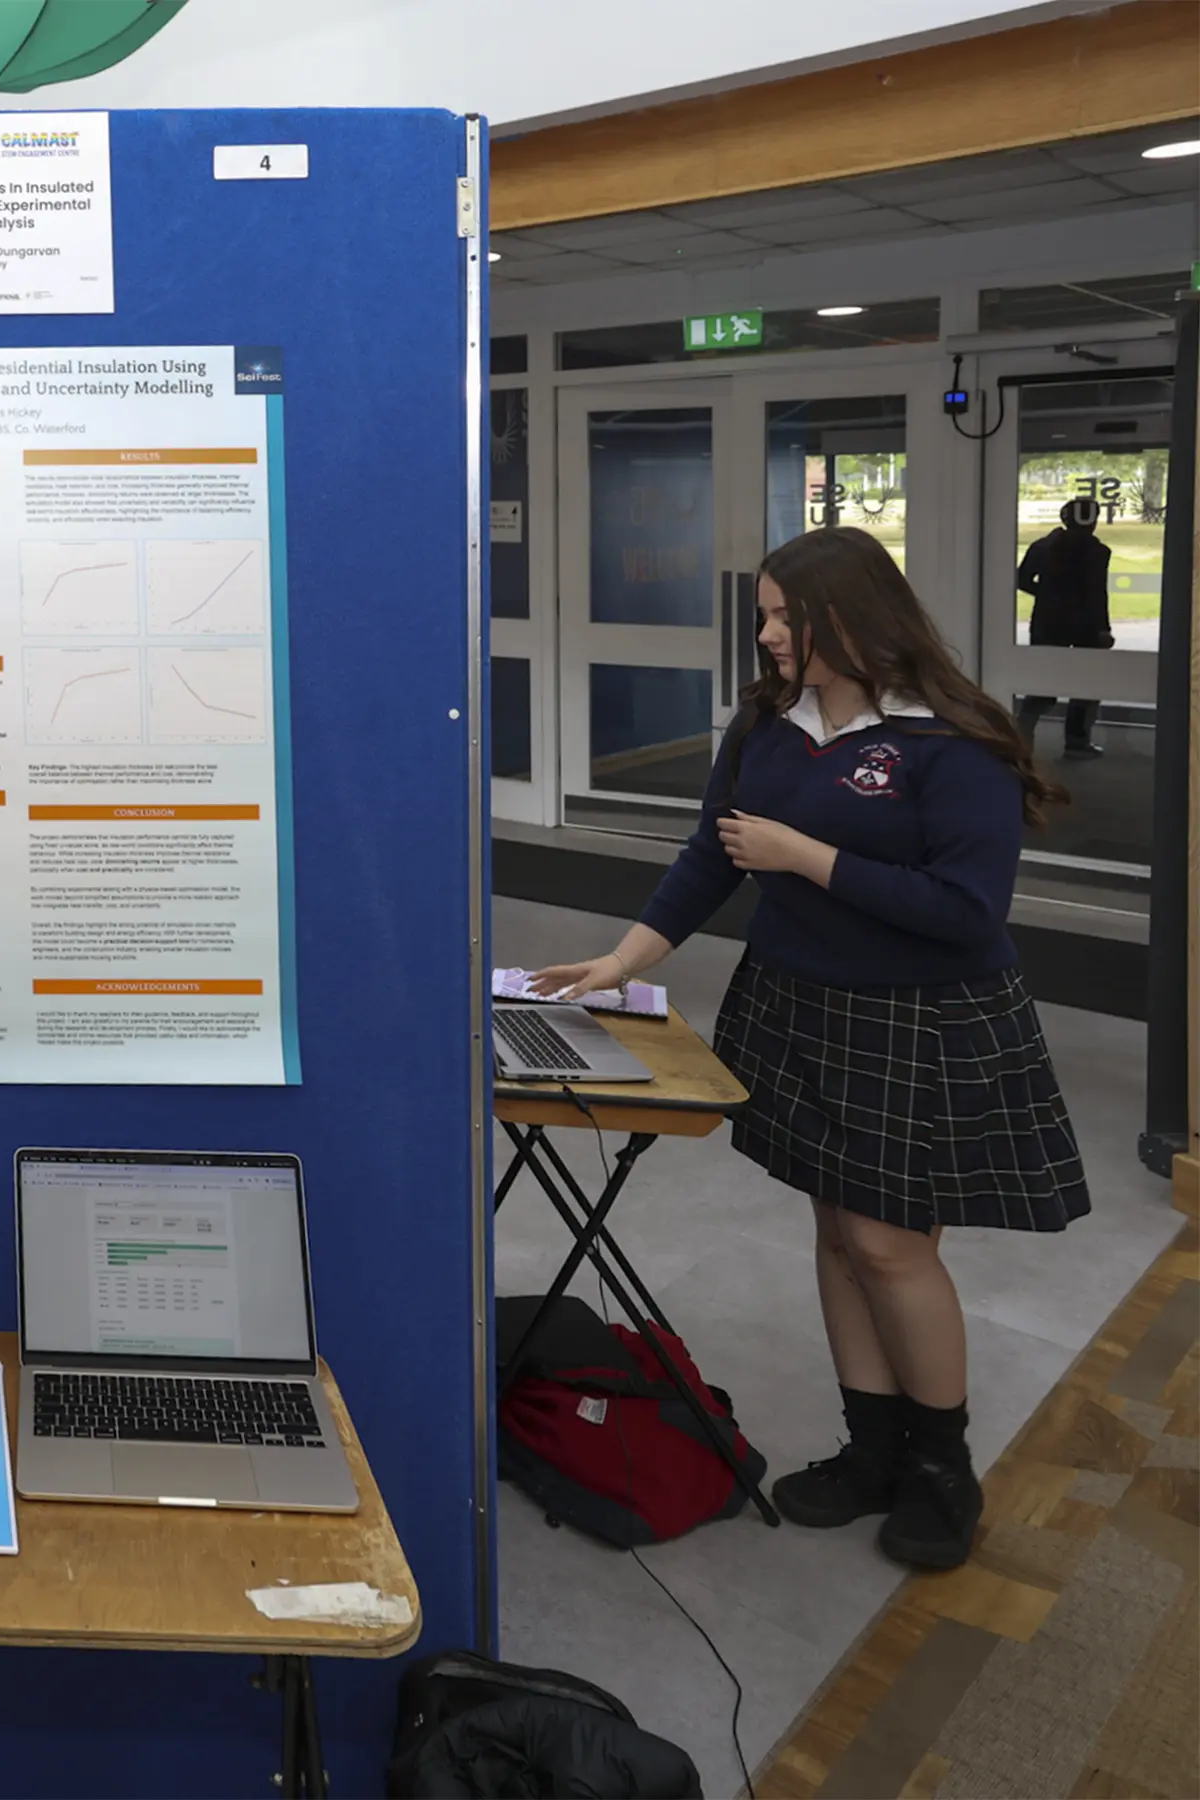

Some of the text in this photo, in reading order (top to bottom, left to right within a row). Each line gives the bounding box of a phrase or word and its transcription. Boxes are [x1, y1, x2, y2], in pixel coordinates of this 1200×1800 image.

[1, 131, 80, 148] CALMAST
[259, 156, 272, 171] 4
[9, 182, 22, 194] In
[26, 180, 94, 193] Insulated
[77, 358, 158, 375] Insulation
[162, 358, 207, 379] Using
[0, 381, 32, 396] and
[35, 379, 130, 399] Uncertainty
[134, 378, 214, 397] Modelling
[7, 405, 42, 420] Hickey
[33, 421, 87, 434] Waterford
[120, 452, 161, 462] RESULTS
[113, 808, 176, 818] CONCLUSION
[95, 982, 201, 993] ACKNOWLEDGEMENTS
